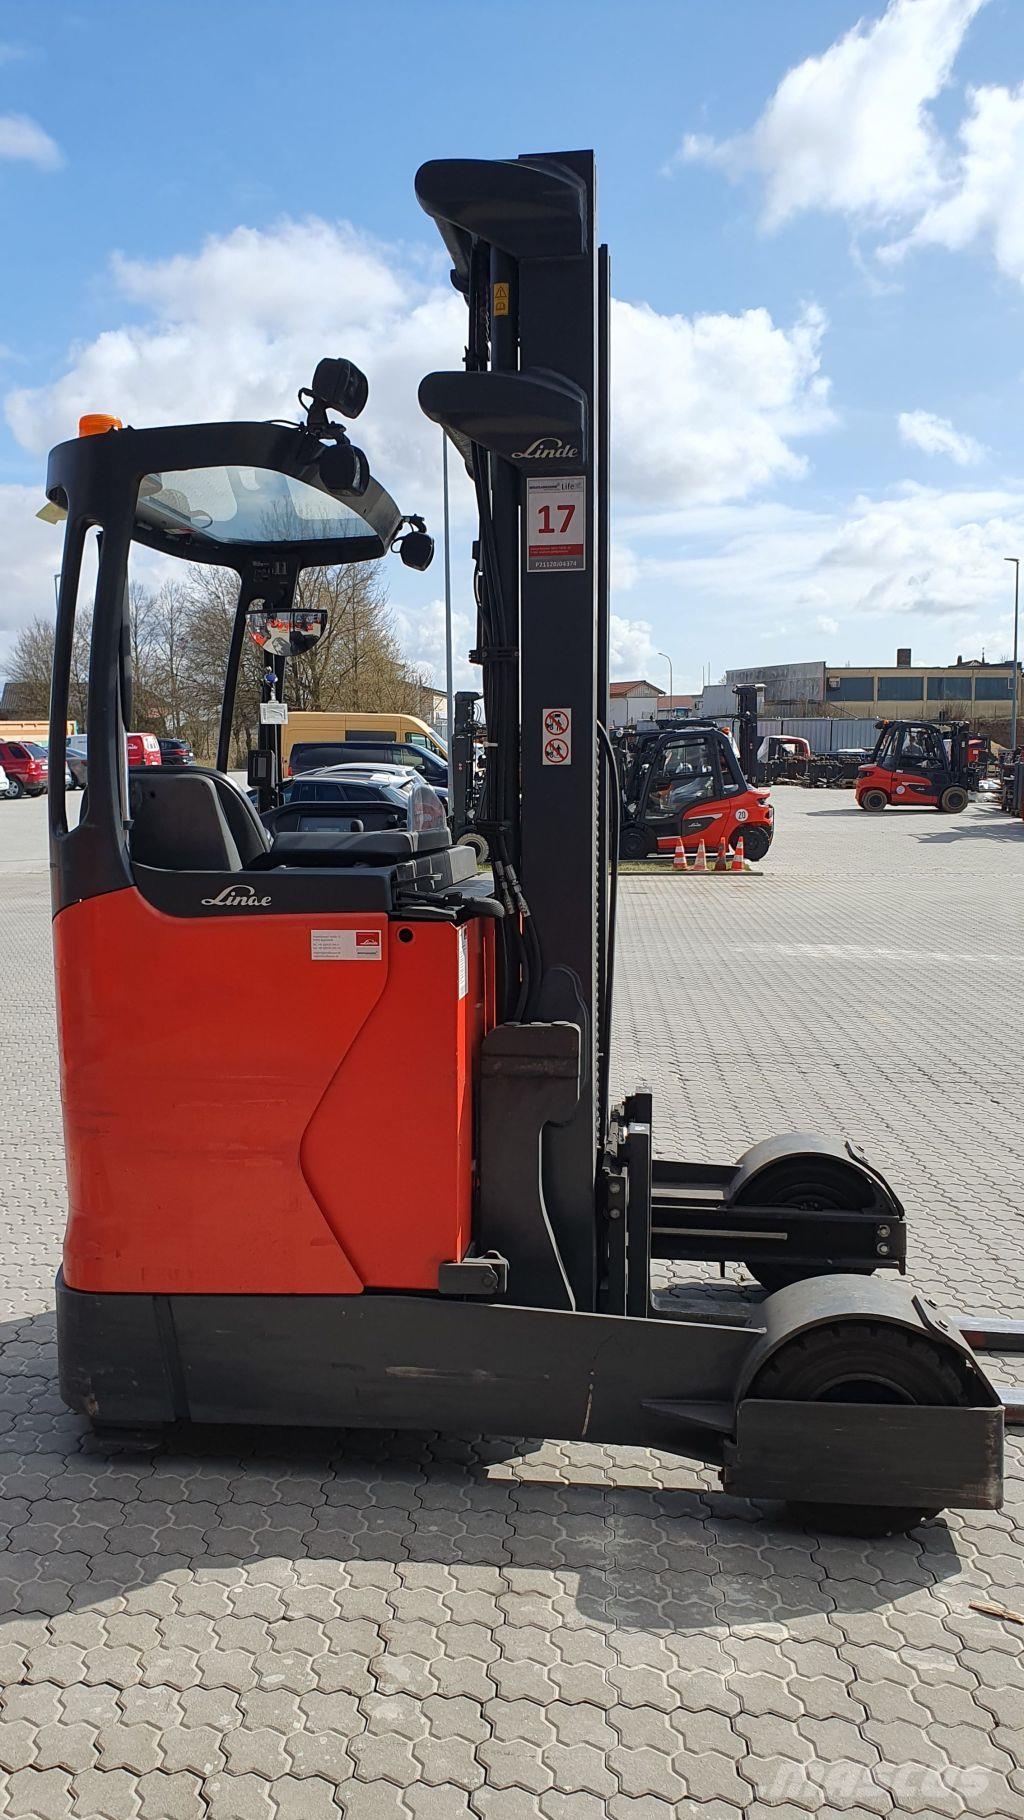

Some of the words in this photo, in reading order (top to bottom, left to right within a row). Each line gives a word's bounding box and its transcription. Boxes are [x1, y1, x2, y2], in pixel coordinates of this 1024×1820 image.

[511, 437, 578, 459] Linde
[537, 504, 576, 534] 17
[737, 810, 746, 820] 20
